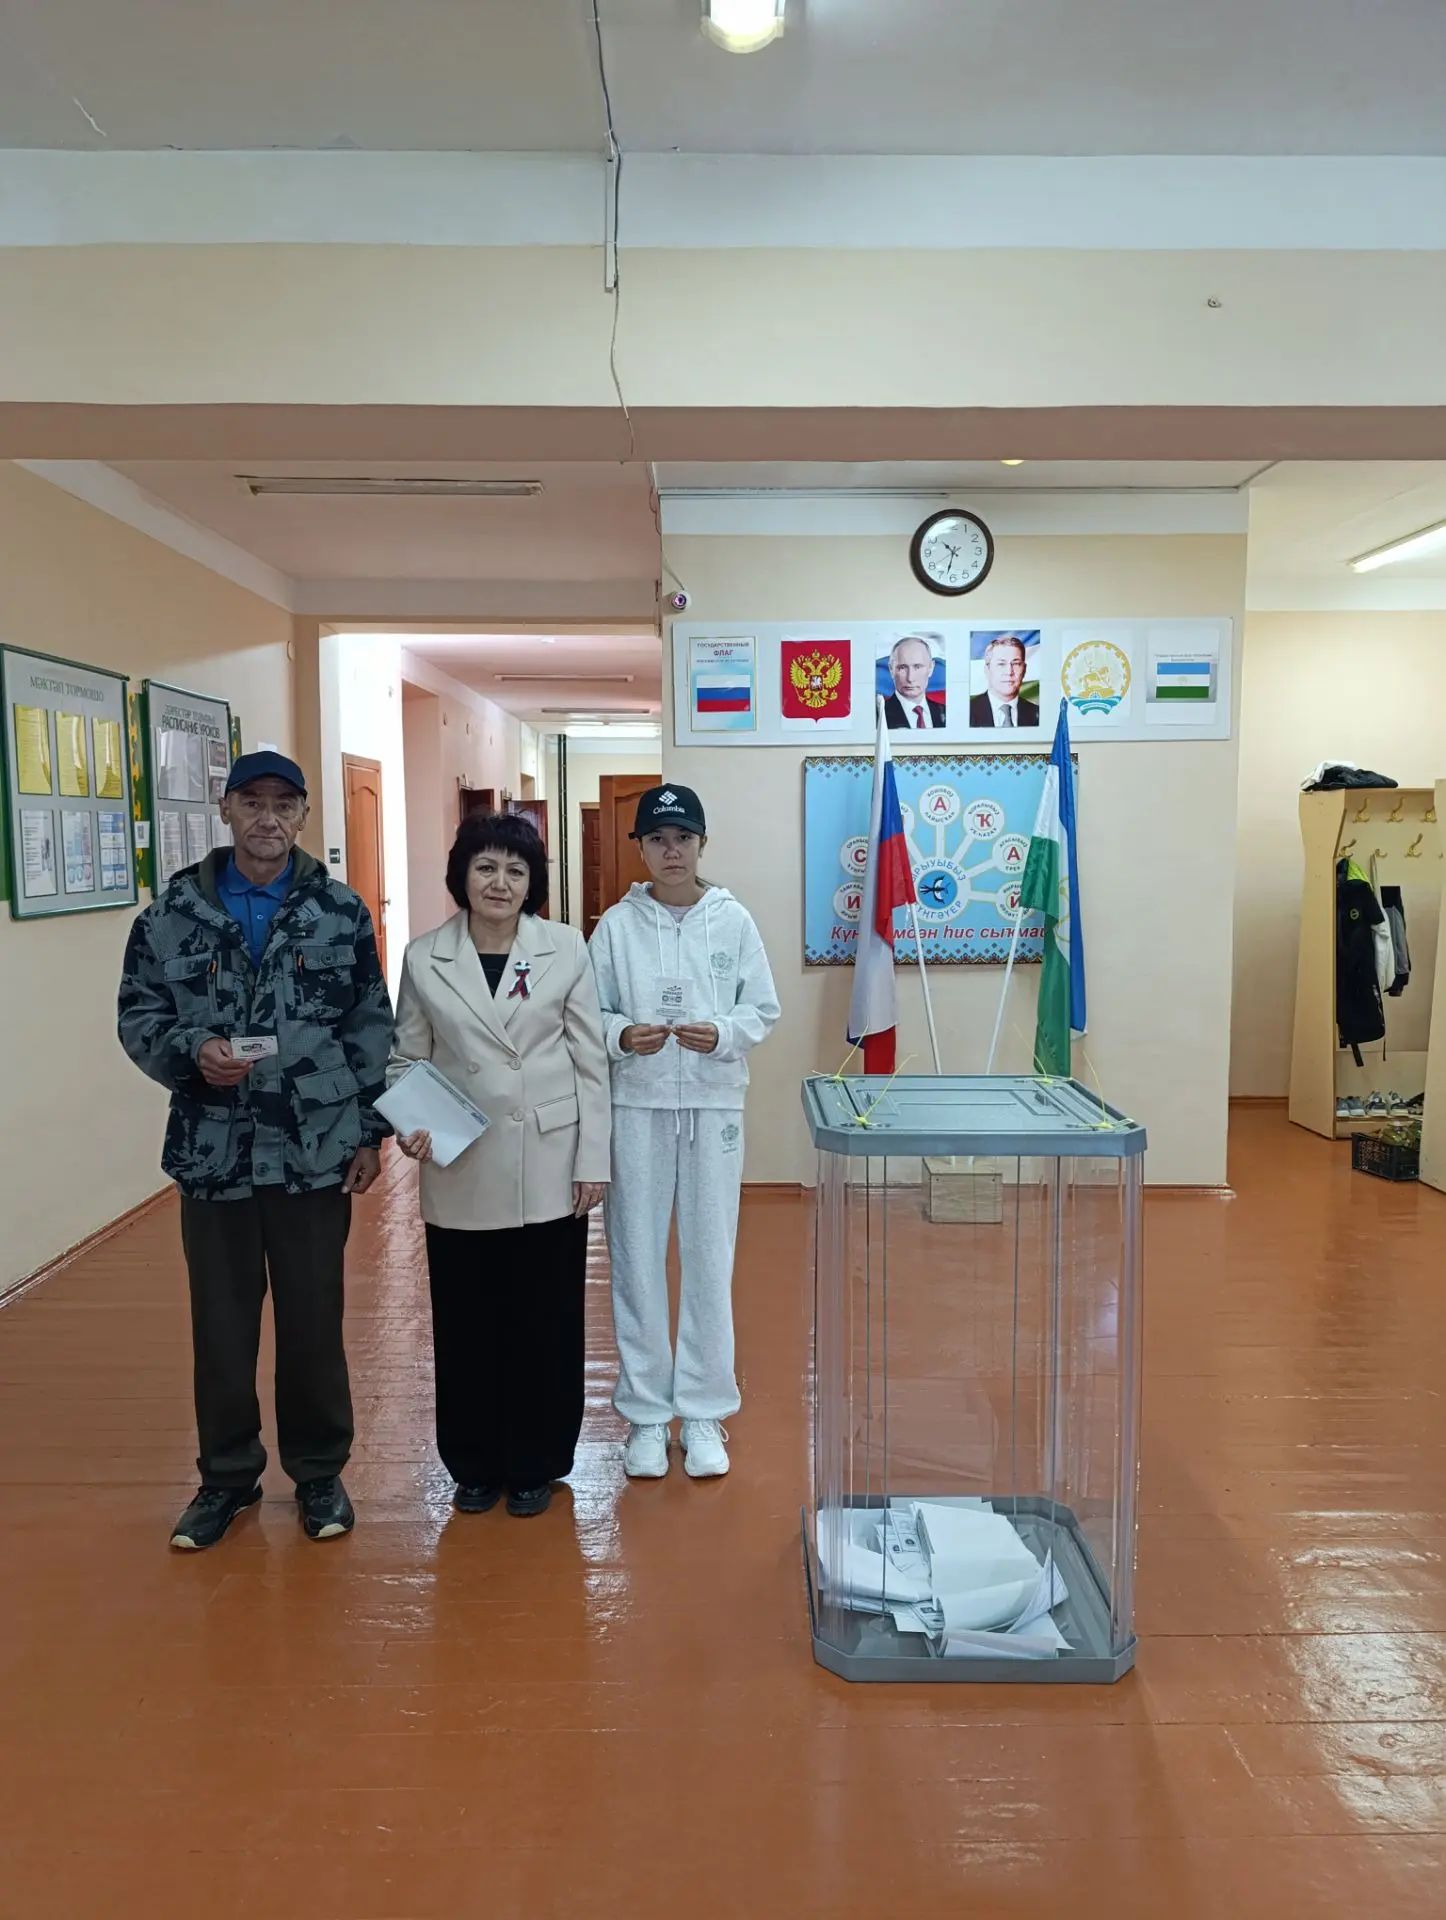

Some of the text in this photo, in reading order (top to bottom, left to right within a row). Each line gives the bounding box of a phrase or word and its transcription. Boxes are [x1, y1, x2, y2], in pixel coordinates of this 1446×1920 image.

[964, 523, 968, 533] 1
[971, 533, 979, 543] 2
[924, 548, 932, 558] 9
[974, 546, 983, 556] 3
[928, 561, 937, 571] 8
[971, 560, 979, 568] 4
[937, 570, 945, 579] 7
[949, 573, 958, 583] 6
[961, 569, 970, 579] 5
[933, 796, 947, 811] А
[653, 805, 686, 815] Columbia
[854, 848, 867, 863] С
[1007, 846, 1021, 861] А
[847, 895, 861, 909] И
